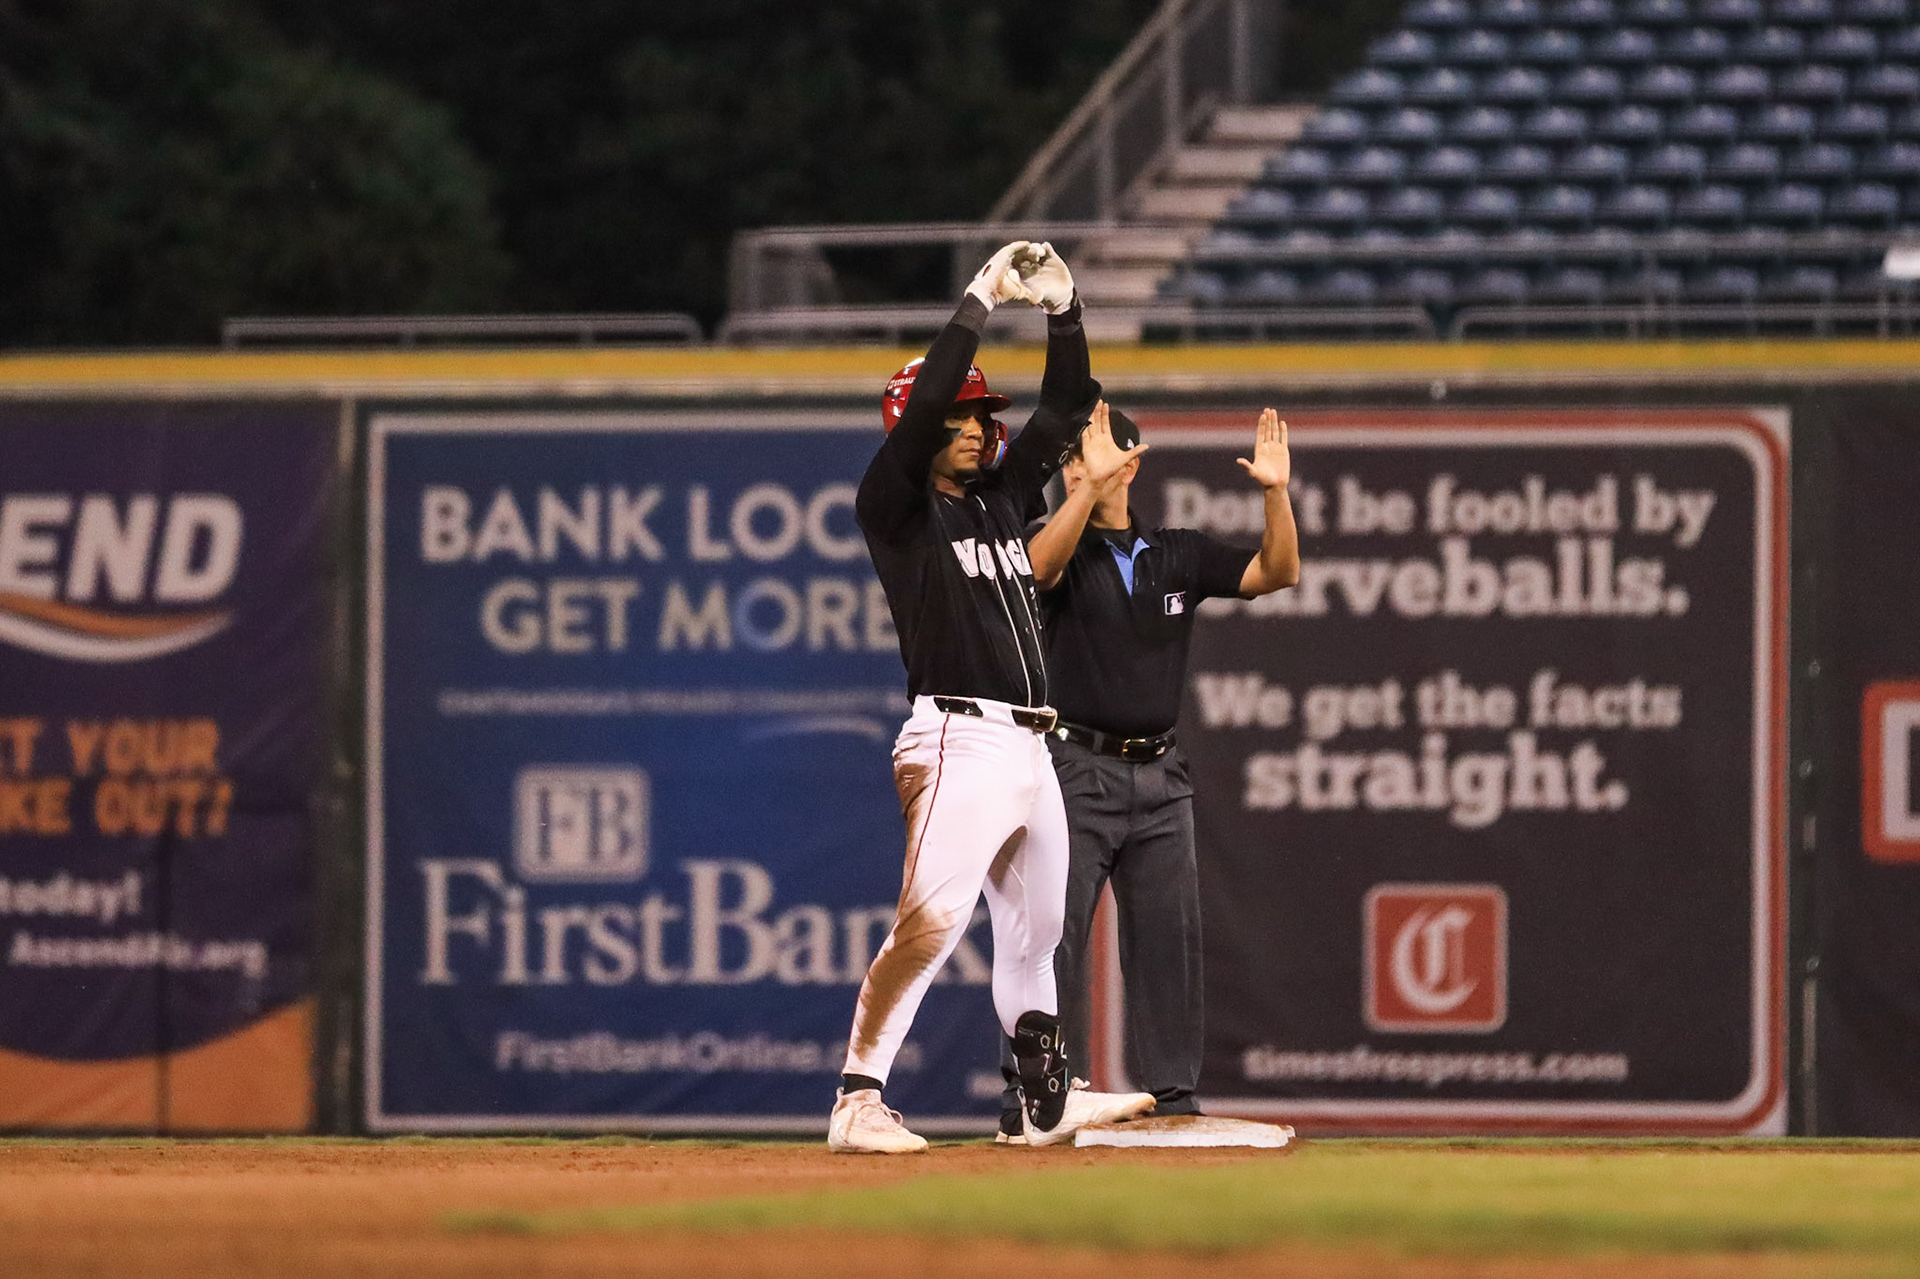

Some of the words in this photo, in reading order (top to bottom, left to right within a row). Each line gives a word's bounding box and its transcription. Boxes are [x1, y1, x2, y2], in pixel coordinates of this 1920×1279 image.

[0, 494, 244, 602] END
[421, 486, 664, 563] BANK
[688, 482, 871, 562] LOC
[1337, 474, 1415, 534] be
[1427, 474, 1619, 535] fooled
[1633, 475, 1716, 546] by
[480, 577, 640, 654] GET
[658, 577, 900, 652] MORE
[1195, 537, 1690, 617] rveballs.
[1194, 673, 1293, 729] We
[1303, 679, 1404, 742] get
[1416, 670, 1517, 729] the
[1527, 669, 1682, 729] facts
[67, 718, 220, 775] YOUR
[1244, 733, 1628, 829] straight.
[536, 783, 643, 864] FB
[496, 1031, 923, 1074] FirstBankOnline.cm
[1243, 1044, 1629, 1086] timesfreepress.com
